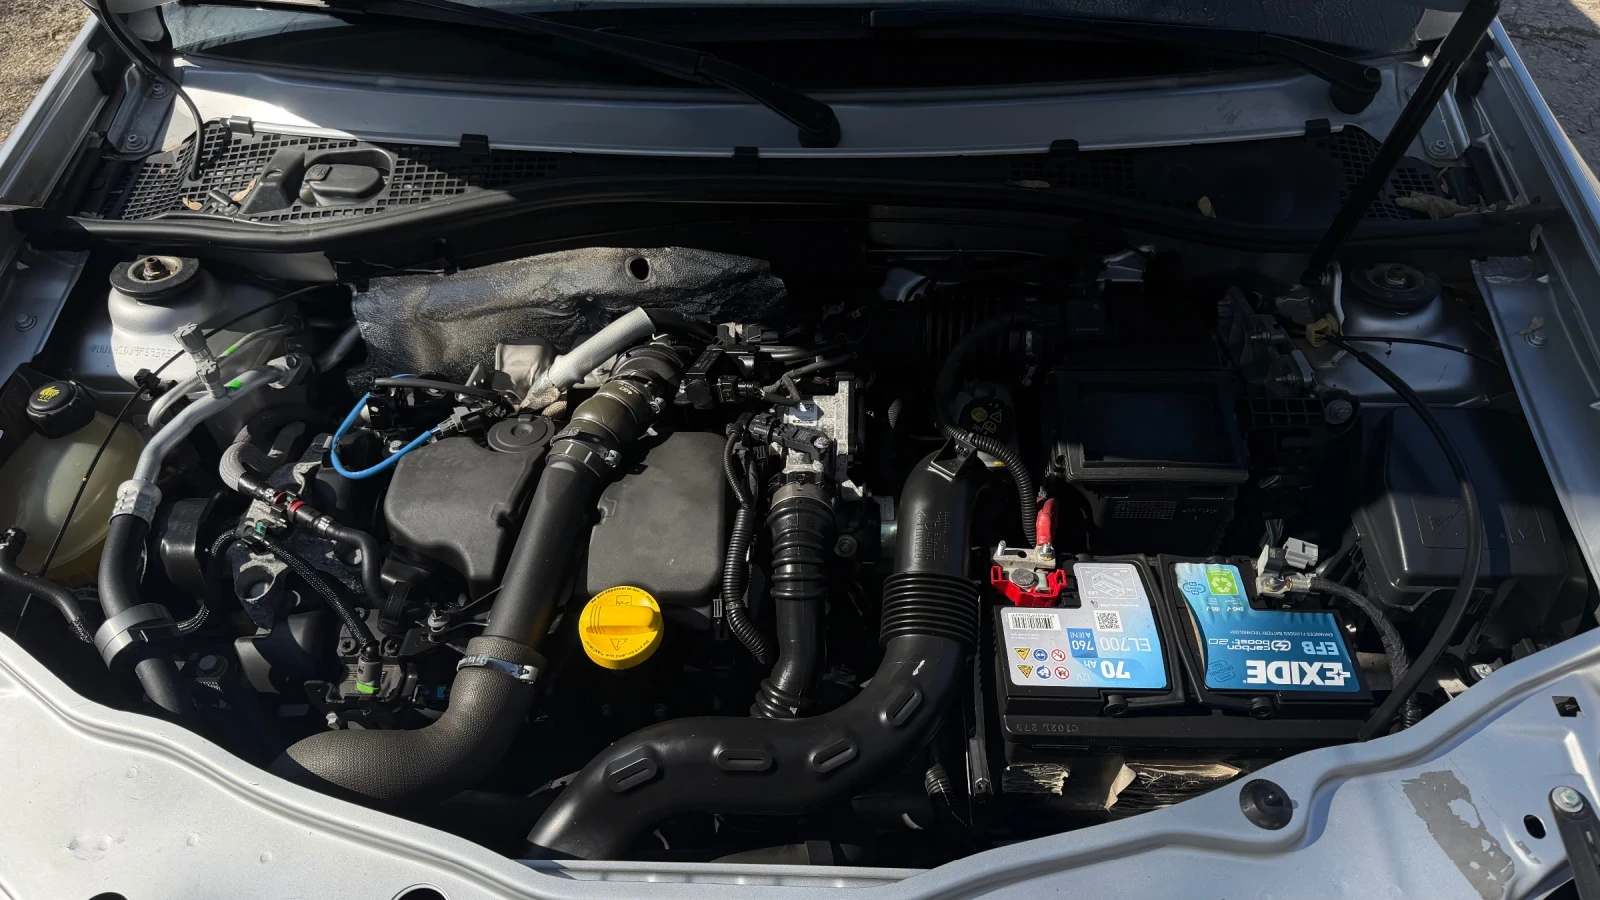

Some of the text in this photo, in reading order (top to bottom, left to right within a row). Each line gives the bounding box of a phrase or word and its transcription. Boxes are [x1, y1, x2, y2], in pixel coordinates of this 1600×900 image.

[1071, 640, 1095, 651] 760
[1099, 636, 1152, 652] EL700
[1301, 641, 1340, 655] EFB
[1083, 659, 1131, 679] 70 Ah
[1245, 660, 1351, 687] EXIDE
